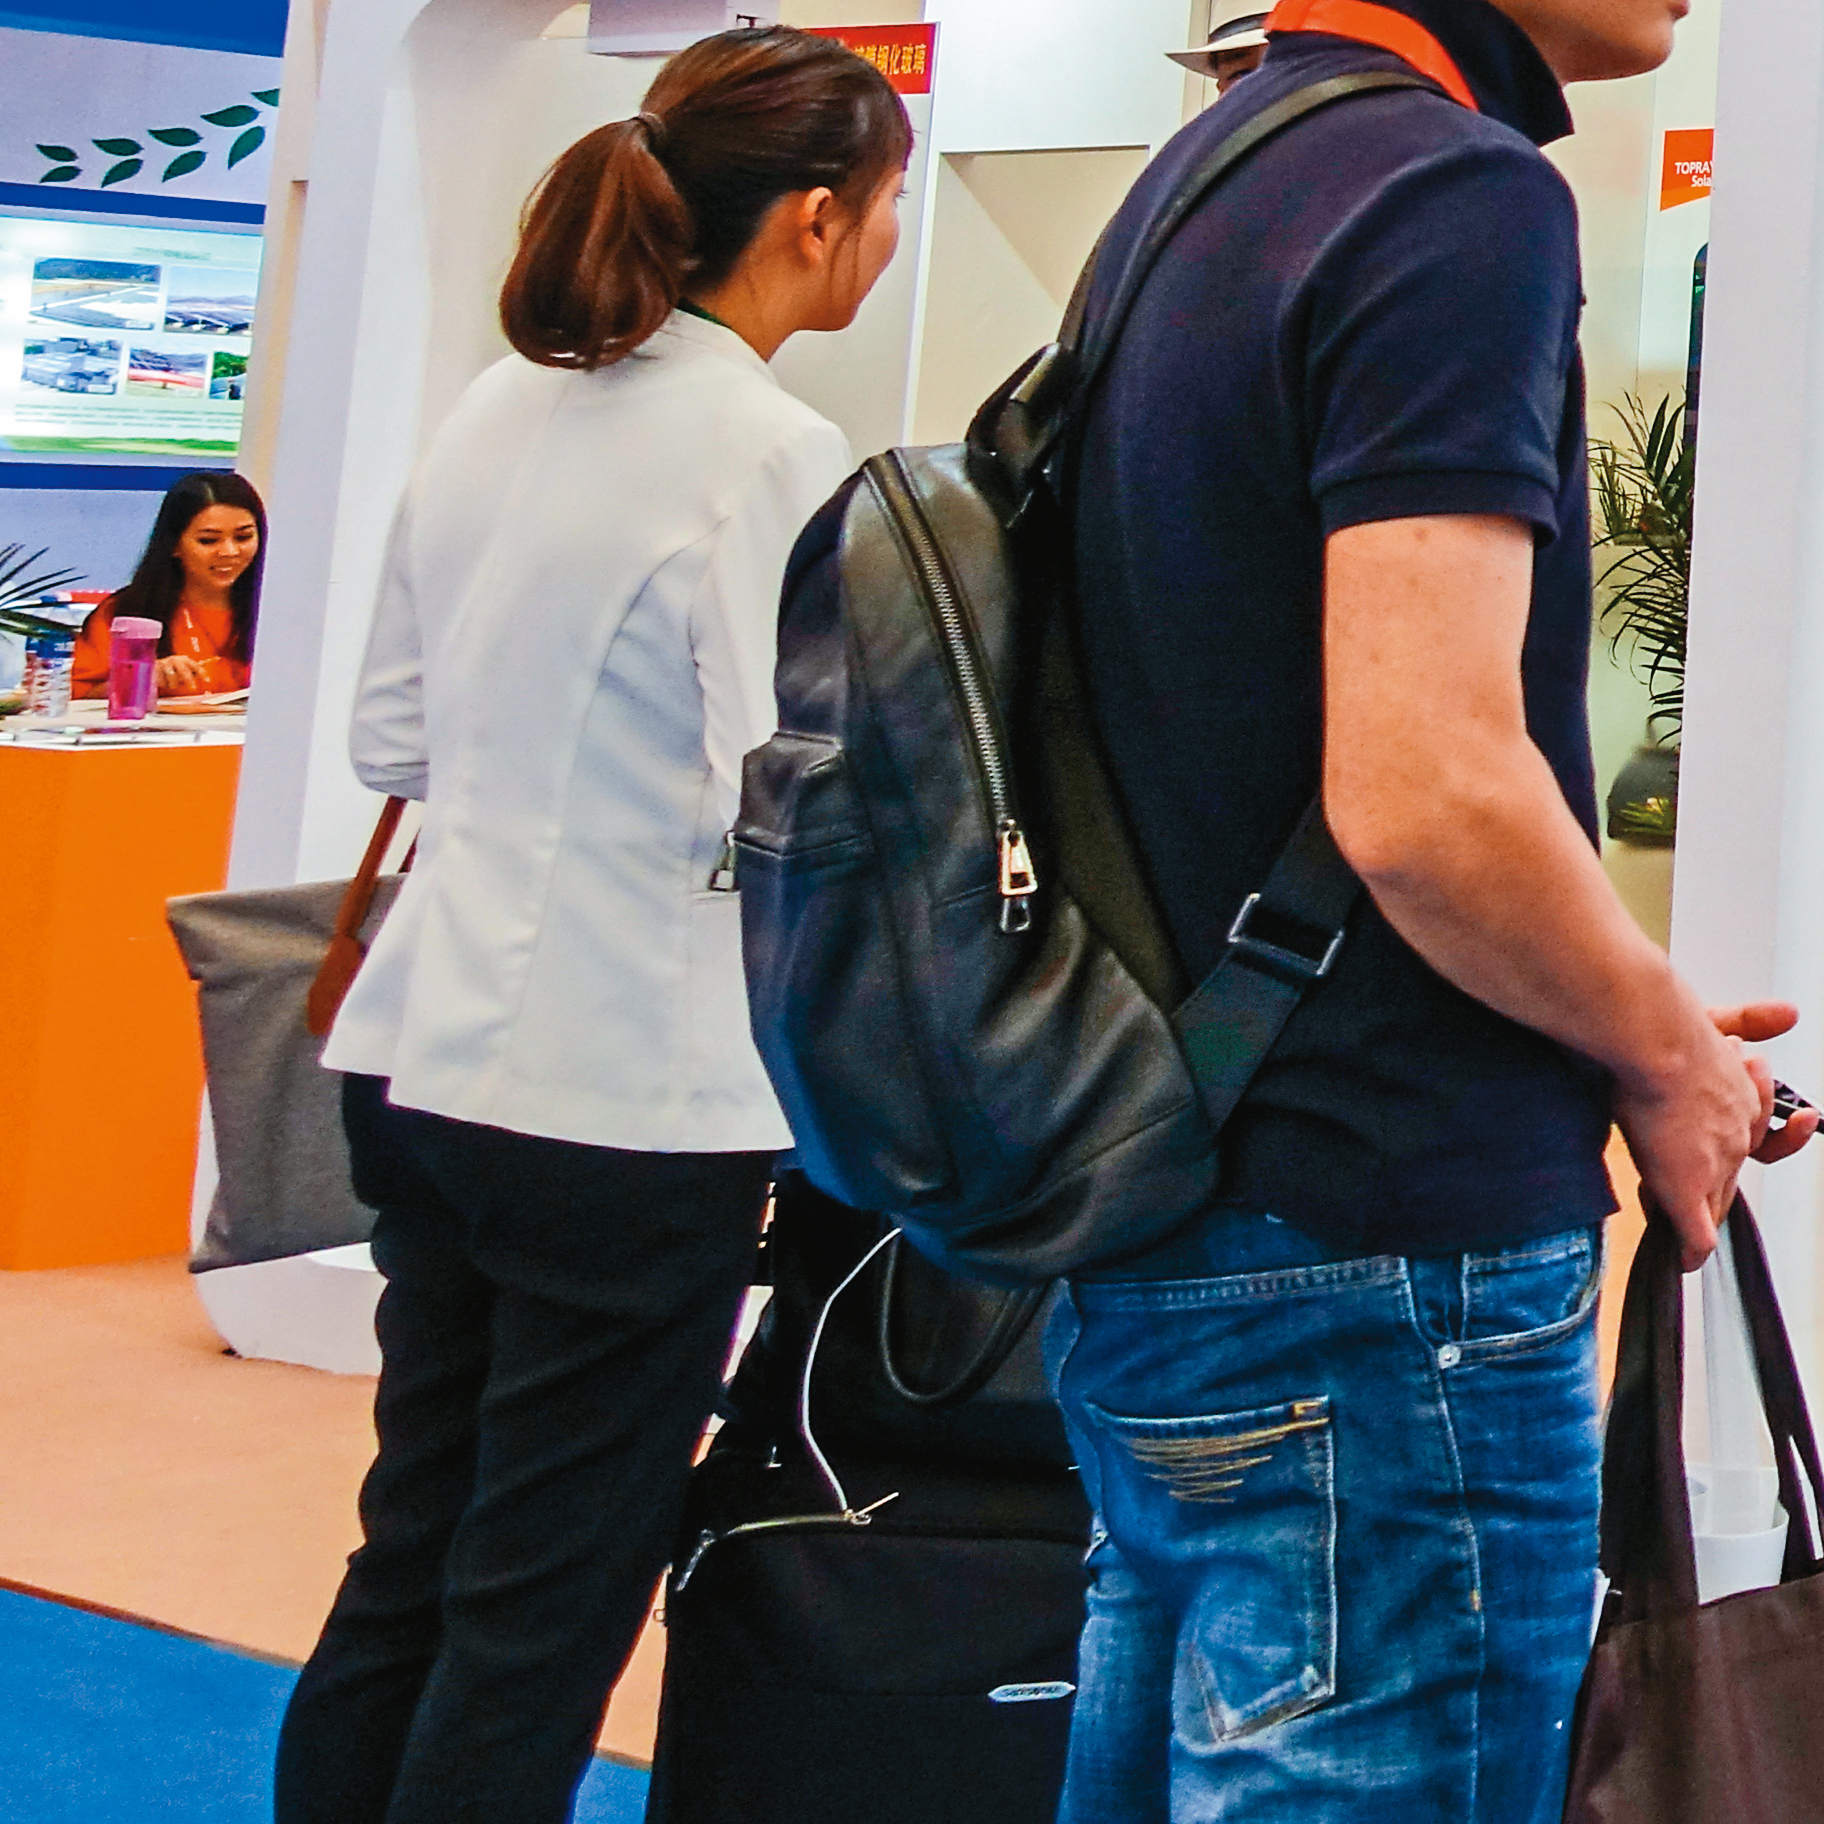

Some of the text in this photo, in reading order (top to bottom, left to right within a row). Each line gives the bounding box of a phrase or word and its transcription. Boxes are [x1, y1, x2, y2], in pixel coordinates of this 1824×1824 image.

[854, 43, 927, 75] 钢化玻璃
[1691, 174, 1712, 187] Sola
